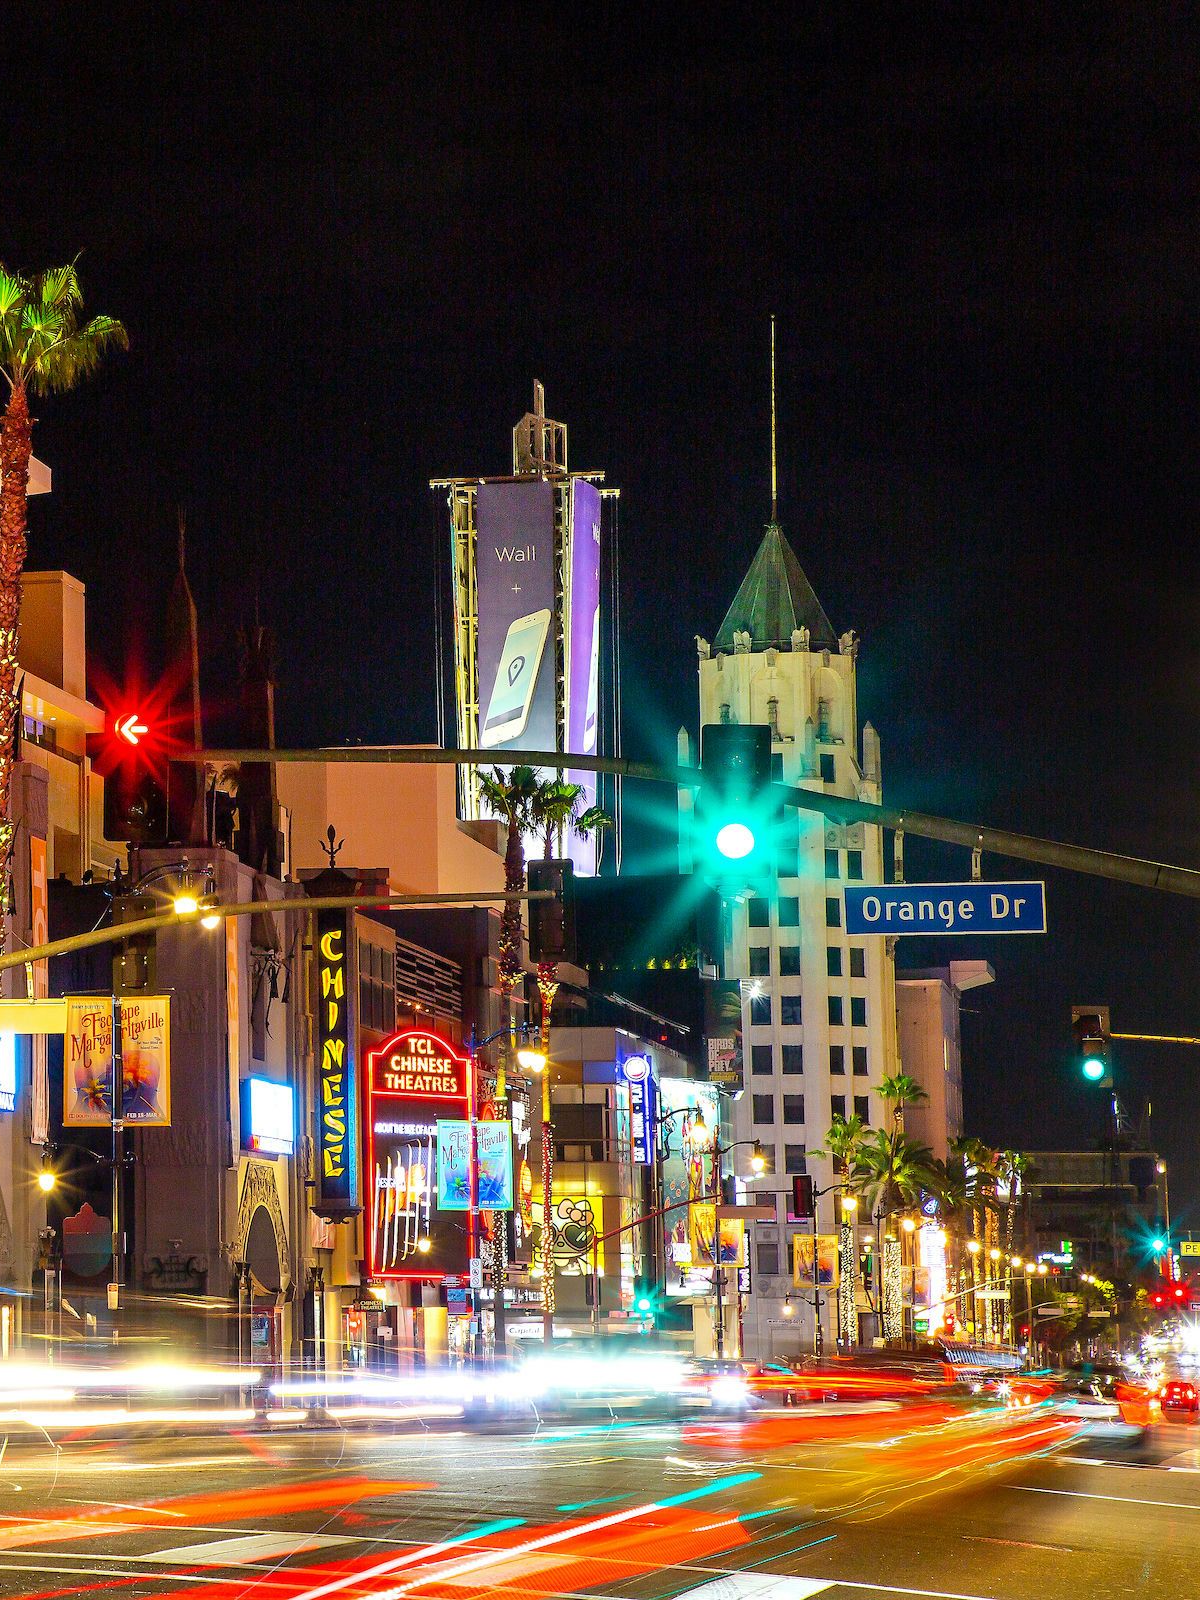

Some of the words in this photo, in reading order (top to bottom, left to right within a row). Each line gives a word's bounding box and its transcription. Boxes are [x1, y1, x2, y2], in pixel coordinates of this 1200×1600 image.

[494, 545, 536, 562] Wall
[862, 896, 975, 928] Orange
[990, 893, 1026, 919] Dr
[81, 1005, 140, 1038] Escape
[70, 1012, 164, 1068] Margaritaville
[408, 1038, 434, 1055] TCL
[708, 1039, 734, 1050] BIRDS
[320, 930, 347, 1178] CHINESE
[390, 1055, 452, 1074] CHINESE
[385, 1073, 458, 1093] THEATRES
[1185, 1244, 1199, 1253] PE
